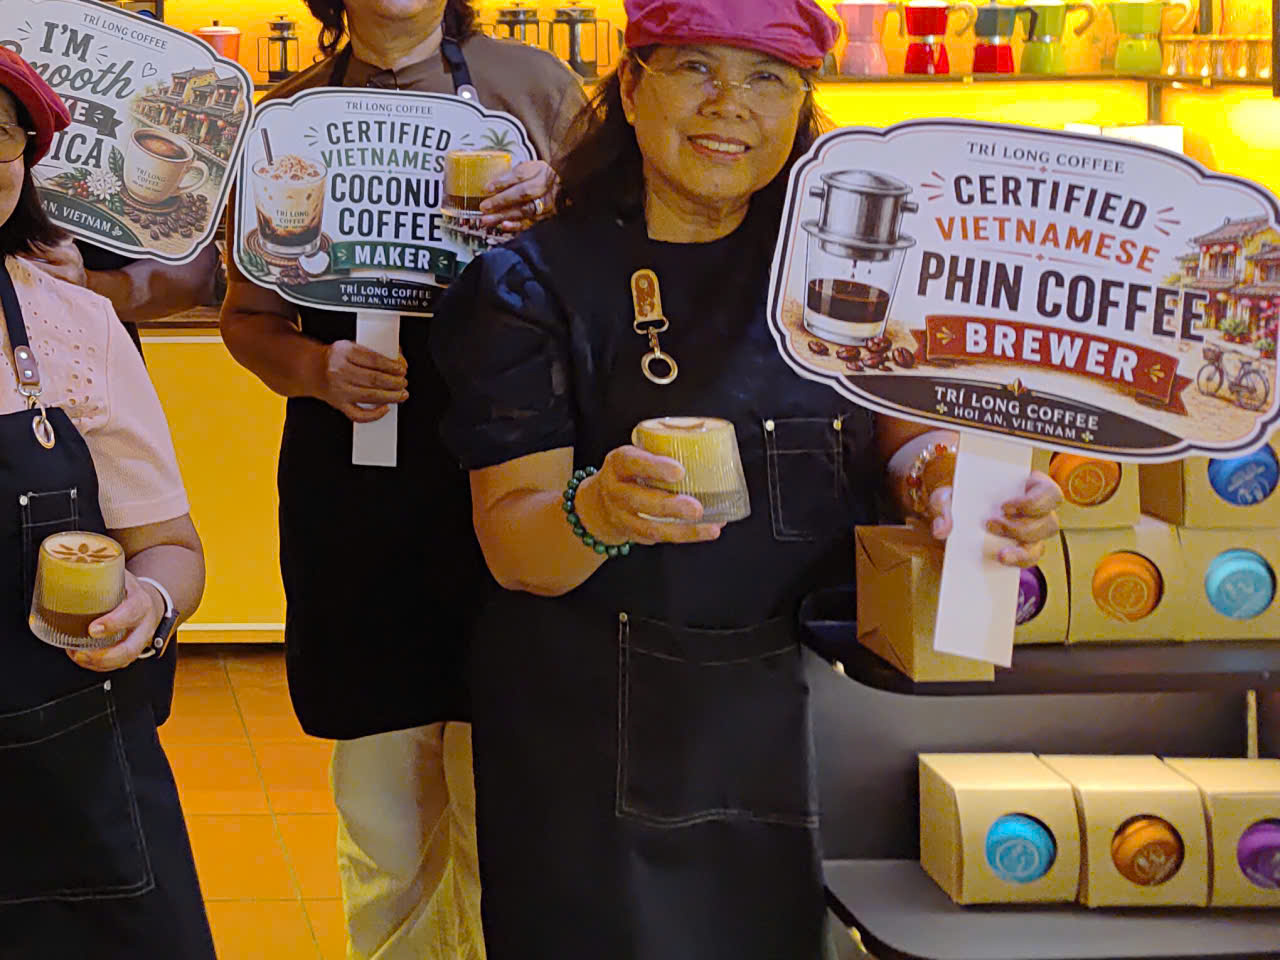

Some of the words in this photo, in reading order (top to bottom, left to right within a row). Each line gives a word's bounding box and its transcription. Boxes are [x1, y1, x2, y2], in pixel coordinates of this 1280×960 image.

[39, 21, 95, 63] I'M
[83, 12, 101, 26] TRÍ
[102, 19, 129, 36] LONG
[130, 30, 168, 50] COFFEE
[345, 101, 362, 110] TRÍ
[365, 102, 393, 112] LONG
[395, 104, 433, 115] COFFEE
[326, 120, 451, 152] CERTIFIED
[321, 147, 445, 174] VIETNAMES
[967, 141, 996, 157] TRÍ
[1003, 146, 1051, 164] LONG
[1056, 153, 1125, 174] COFFEE
[331, 172, 441, 209] COCONU
[953, 174, 1147, 230] CERTIFIED
[63, 205, 111, 233] VIETNAM
[339, 207, 443, 242] COFFEE
[354, 245, 431, 270] MAKER
[934, 215, 1161, 273] VIETNAMESE
[340, 283, 358, 295] TRÍ
[361, 286, 389, 297] LONG
[392, 288, 432, 299] COFFEE
[383, 297, 419, 307] VIETNAM
[917, 250, 1023, 312] PHIN
[1036, 269, 1208, 341] COFFEE
[965, 321, 1139, 383] BREWER
[934, 384, 966, 404] TRÍ
[971, 394, 1021, 416] LONG
[1026, 403, 1099, 431] COFFEE
[953, 406, 981, 421] HOI
[1011, 417, 1077, 440] VIETNAM
